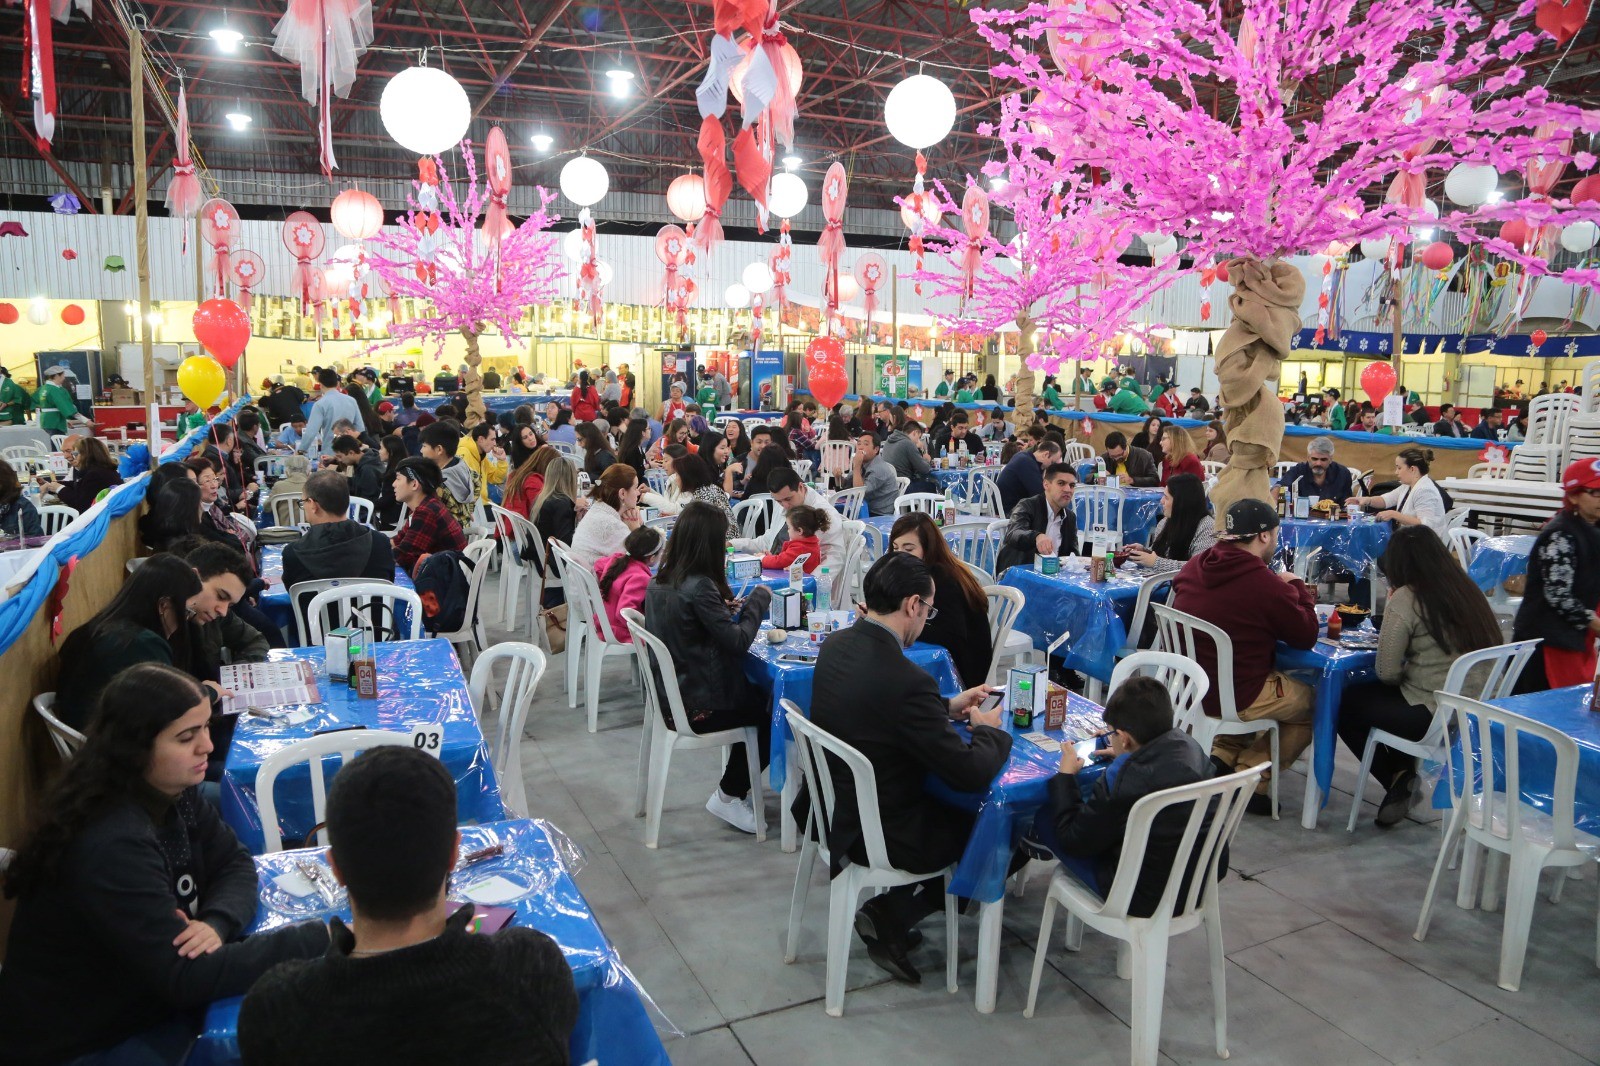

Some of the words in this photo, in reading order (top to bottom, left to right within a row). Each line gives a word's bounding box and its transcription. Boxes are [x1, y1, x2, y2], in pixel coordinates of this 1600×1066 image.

[359, 669, 372, 679] 04
[1051, 699, 1064, 710] 02
[413, 732, 440, 750] 03
